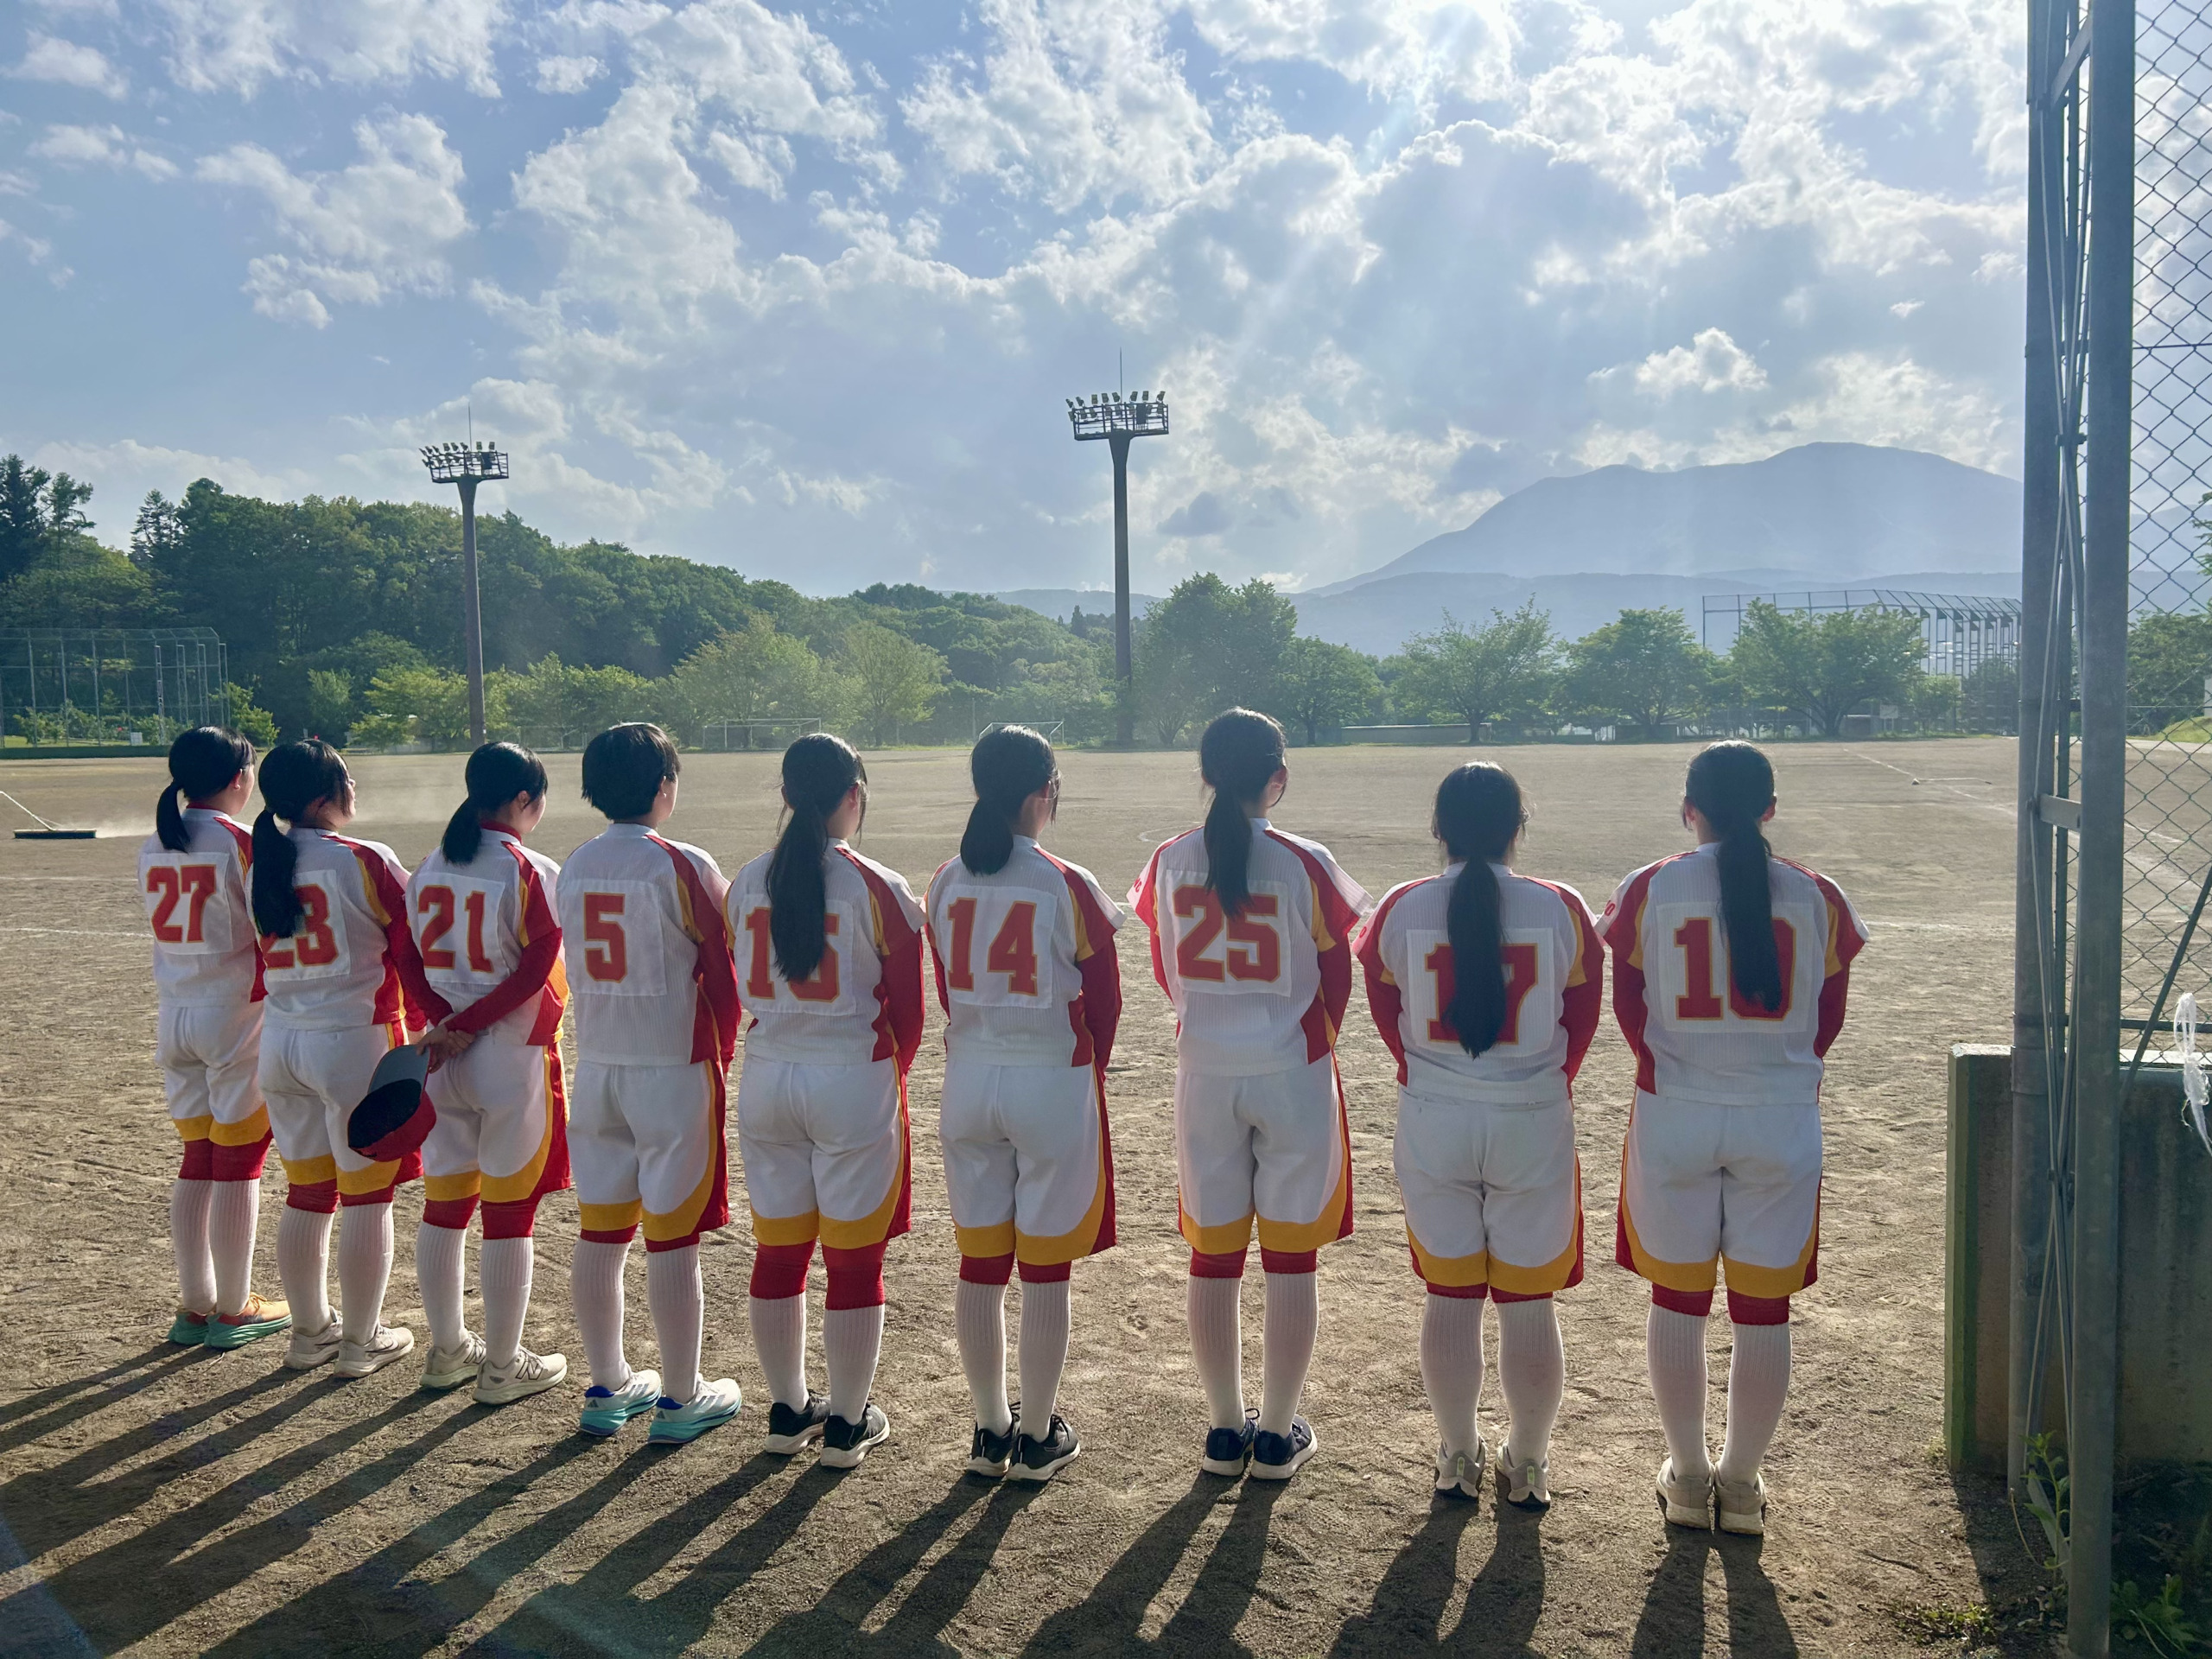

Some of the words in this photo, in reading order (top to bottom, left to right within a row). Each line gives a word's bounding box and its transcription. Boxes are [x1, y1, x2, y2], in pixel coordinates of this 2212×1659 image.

[146, 865, 216, 944] 27
[418, 885, 494, 974] 21
[583, 892, 628, 983] 5
[947, 897, 1039, 996] 14
[1172, 884, 1281, 983] 25
[1424, 943, 1539, 1046] 17
